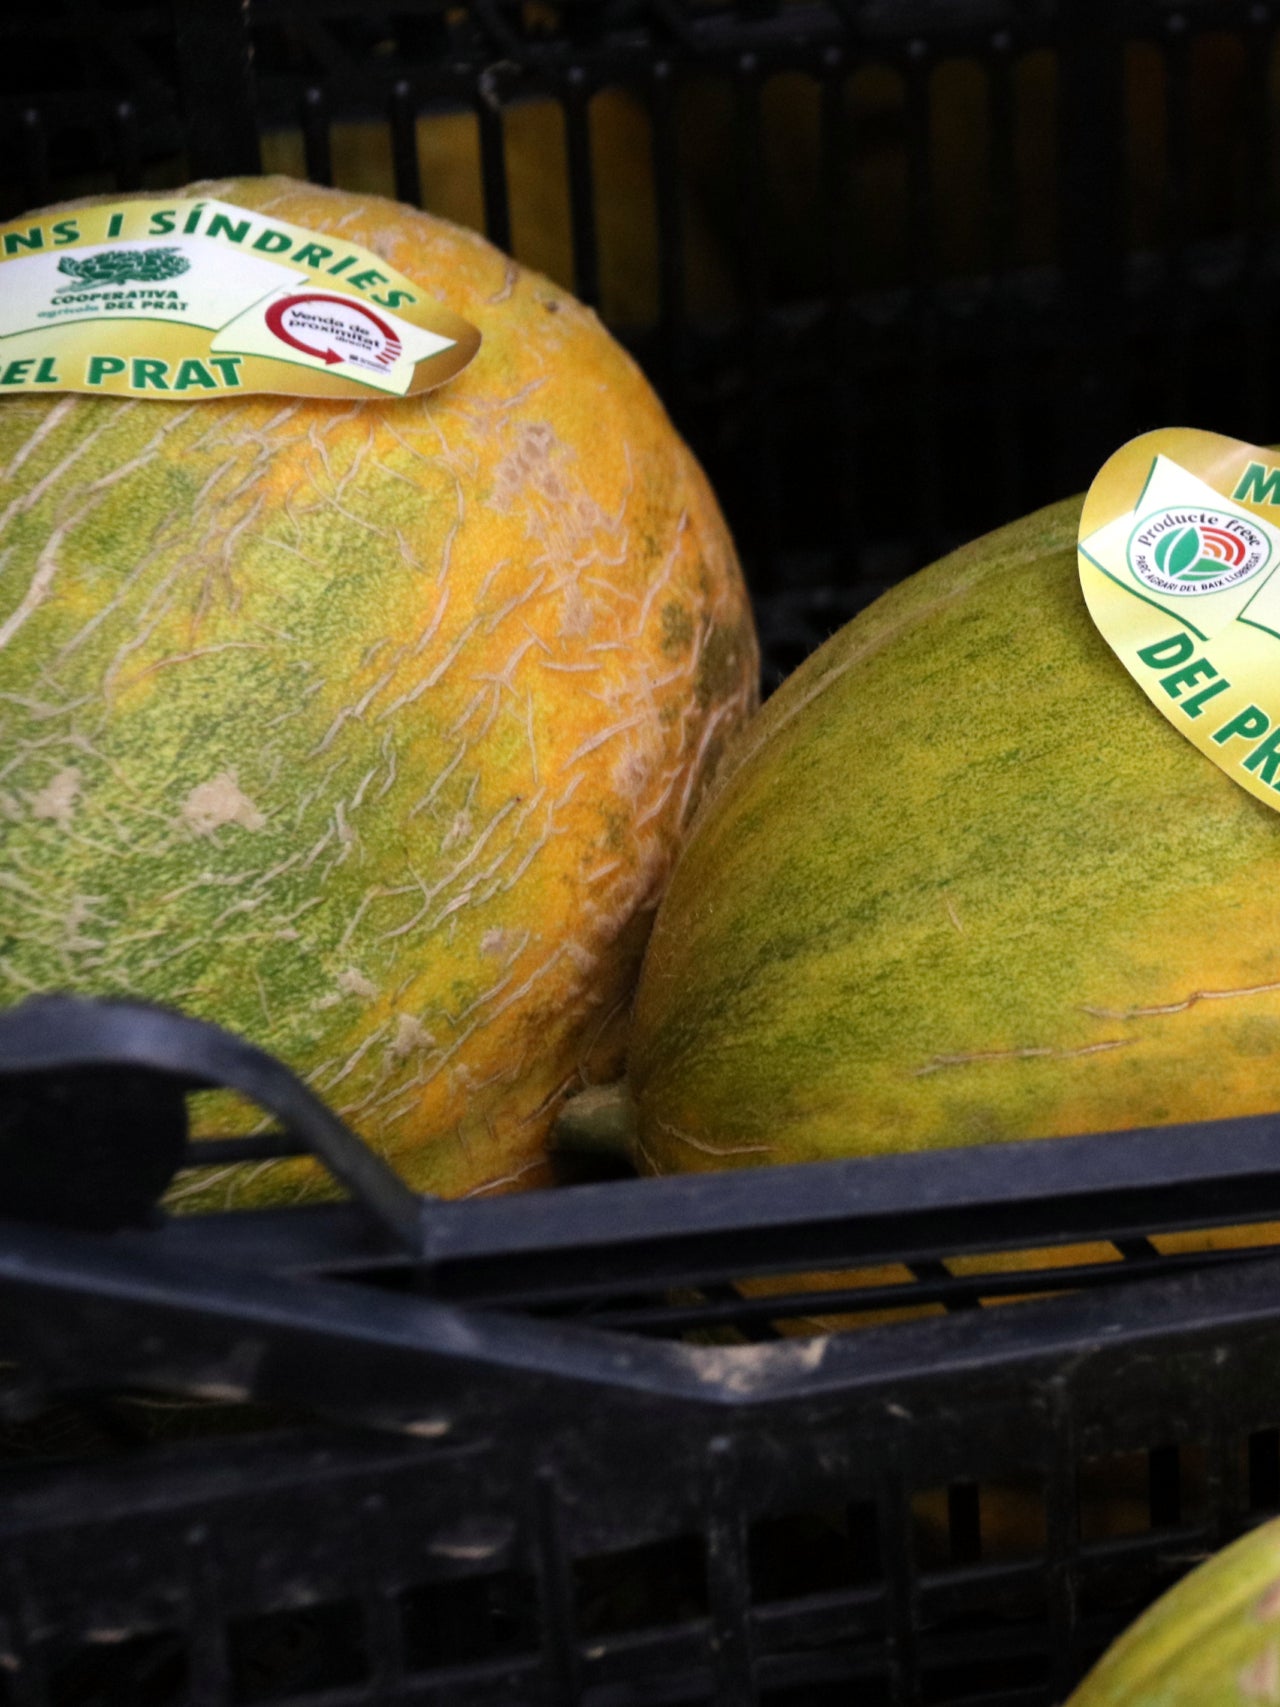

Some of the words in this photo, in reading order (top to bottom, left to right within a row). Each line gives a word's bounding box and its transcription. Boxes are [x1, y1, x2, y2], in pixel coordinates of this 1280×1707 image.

[107, 213, 124, 238] I
[148, 203, 417, 309] SÍNDRIES
[51, 289, 179, 306] COOPERATIVA
[104, 301, 135, 311] DEL
[141, 301, 188, 312] PRAT
[288, 319, 380, 348] proximitat
[290, 309, 344, 328] Venda
[349, 323, 371, 336] de
[0, 357, 59, 386] EL
[86, 356, 242, 391] PRAT
[1224, 519, 1261, 547] fresc
[1146, 574, 1178, 592] AGRARI
[1179, 584, 1198, 592] DEL
[1201, 580, 1223, 591] BAIX
[1136, 631, 1232, 720] DEL
